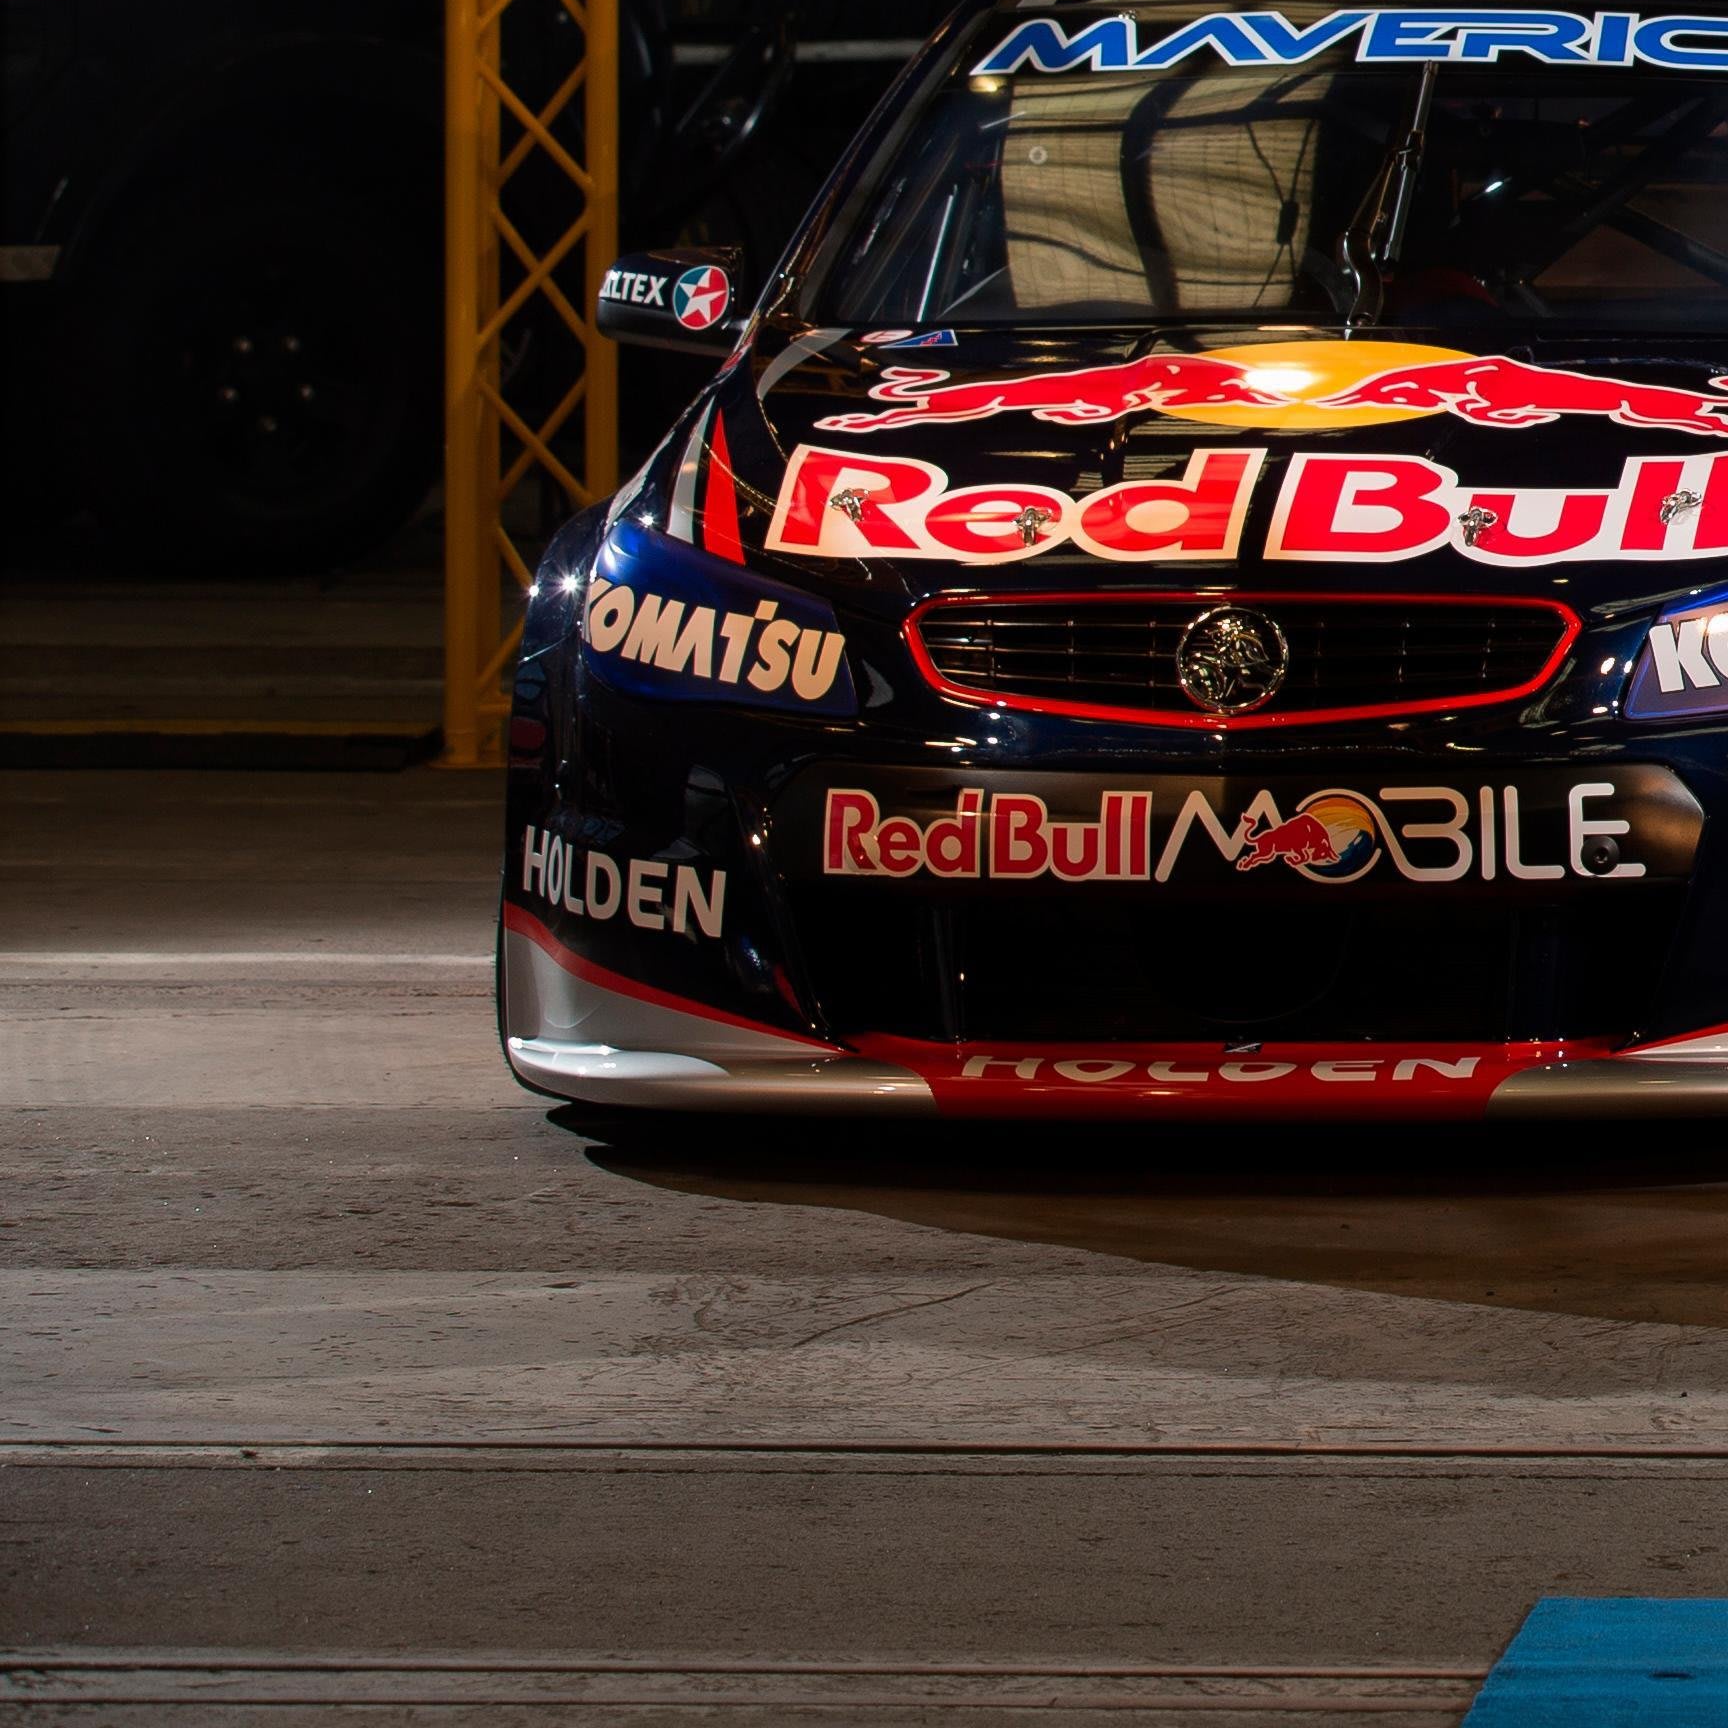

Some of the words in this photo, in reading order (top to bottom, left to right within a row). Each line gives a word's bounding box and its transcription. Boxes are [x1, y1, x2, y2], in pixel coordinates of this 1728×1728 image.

[598, 269, 669, 306] ALTEX
[763, 443, 1269, 564] Red
[521, 824, 727, 939] HOLDEN
[824, 787, 985, 878] Red
[988, 790, 1154, 881] Bull
[1155, 782, 1647, 884] MOBILE
[960, 1054, 1482, 1083] HOLDEN
